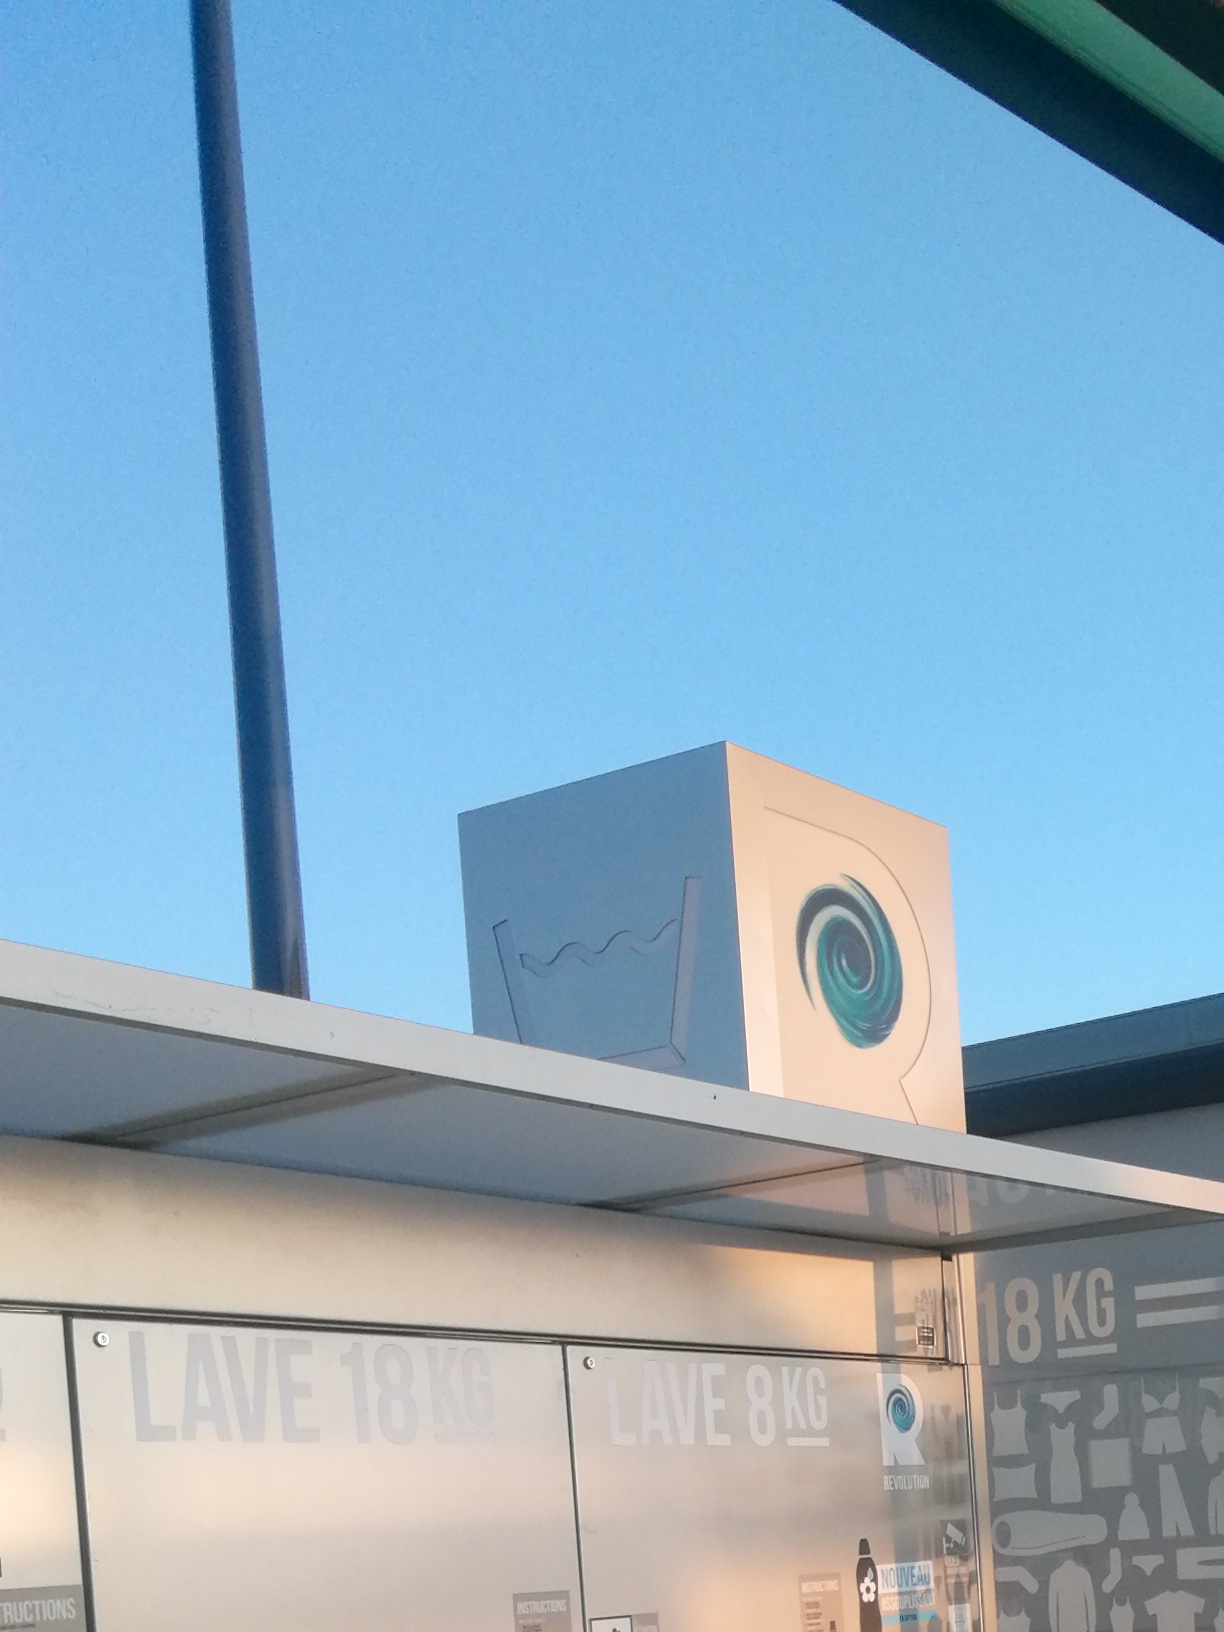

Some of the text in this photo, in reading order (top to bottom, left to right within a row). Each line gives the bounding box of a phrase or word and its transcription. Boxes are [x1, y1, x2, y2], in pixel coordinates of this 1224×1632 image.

[977, 1277, 1042, 1367] 18
[1053, 1267, 1116, 1343] KG
[128, 1331, 495, 1444] LAVE 18 KG
[604, 1357, 829, 1447] LAVE 8 KG
[883, 1474, 930, 1490] REVOLUTION
[881, 1565, 931, 1589] NOUVEAU
[517, 1600, 567, 1615] INSTRUCTIONS
